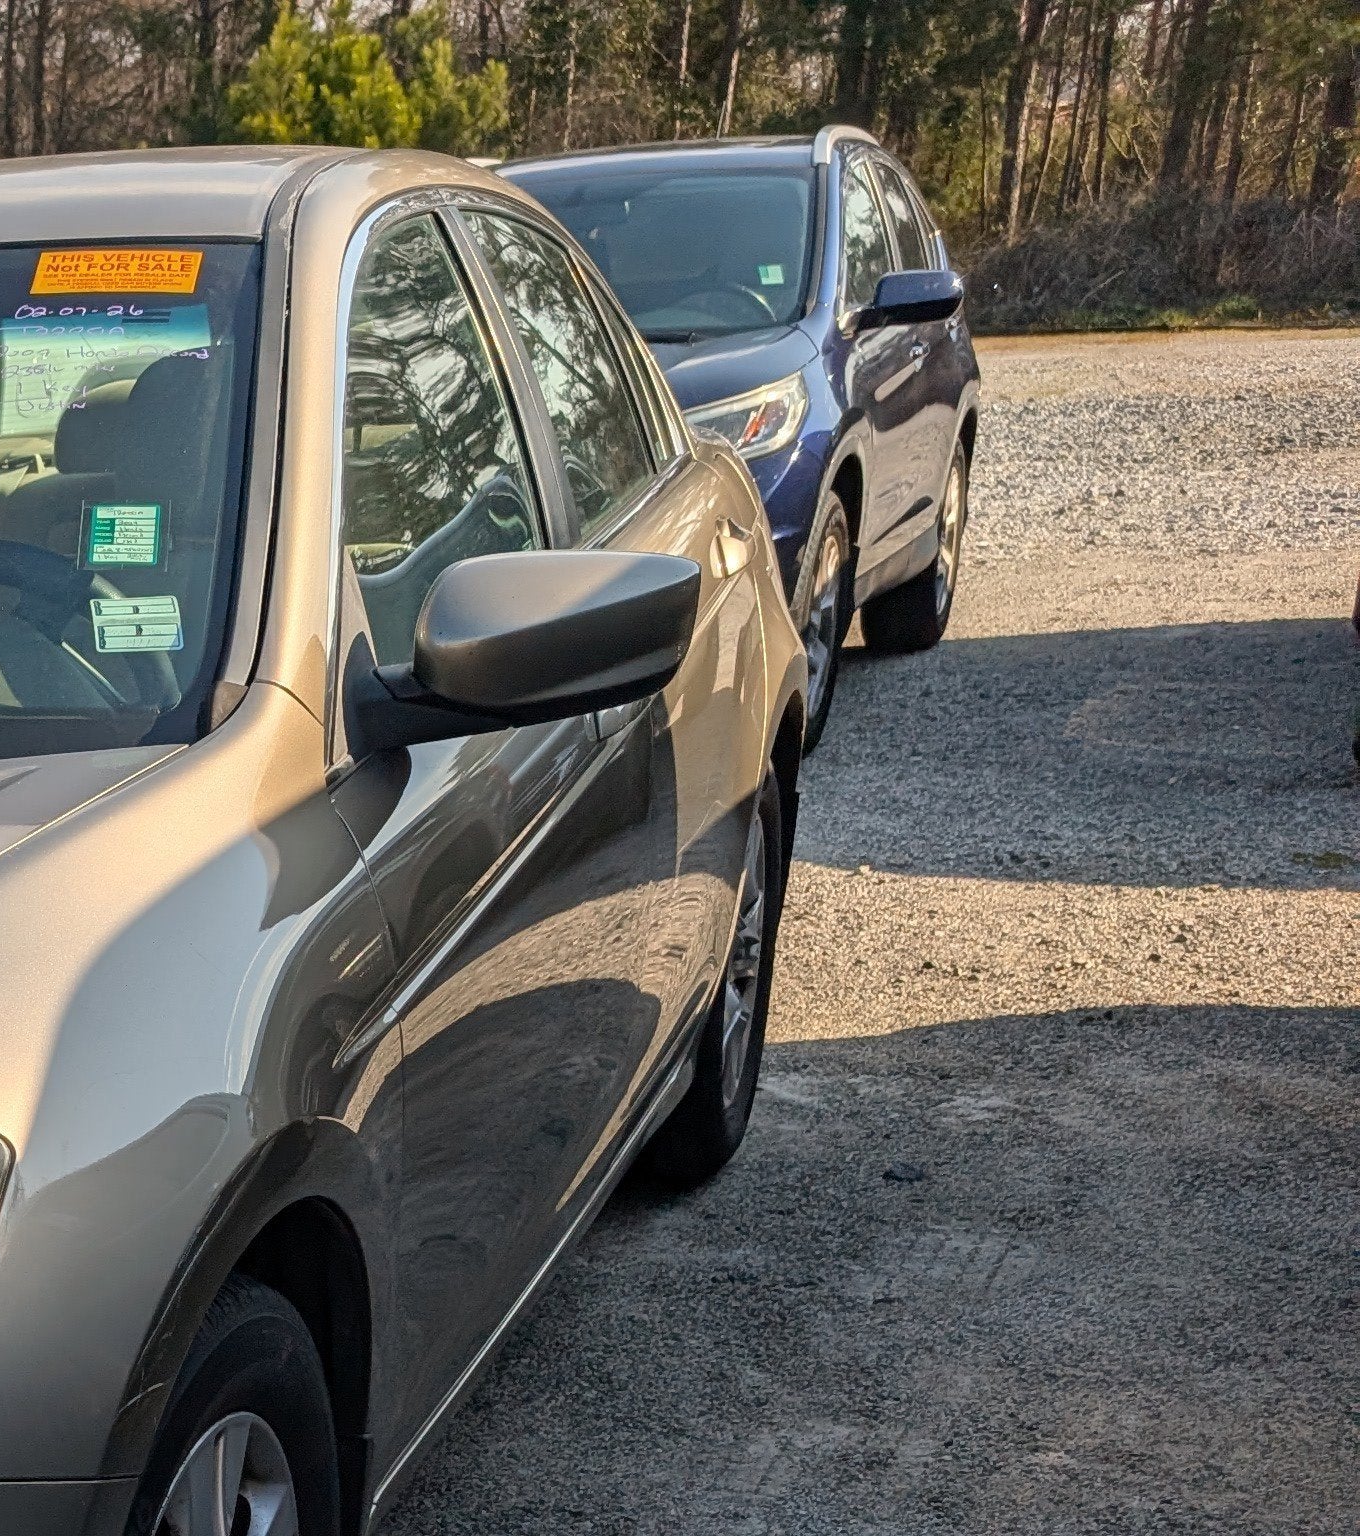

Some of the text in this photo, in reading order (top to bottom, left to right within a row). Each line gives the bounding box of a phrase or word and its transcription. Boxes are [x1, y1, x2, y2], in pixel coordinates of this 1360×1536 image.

[48, 252, 193, 263] THIS VEHICLE
[46, 262, 194, 273] Not FOR SALE
